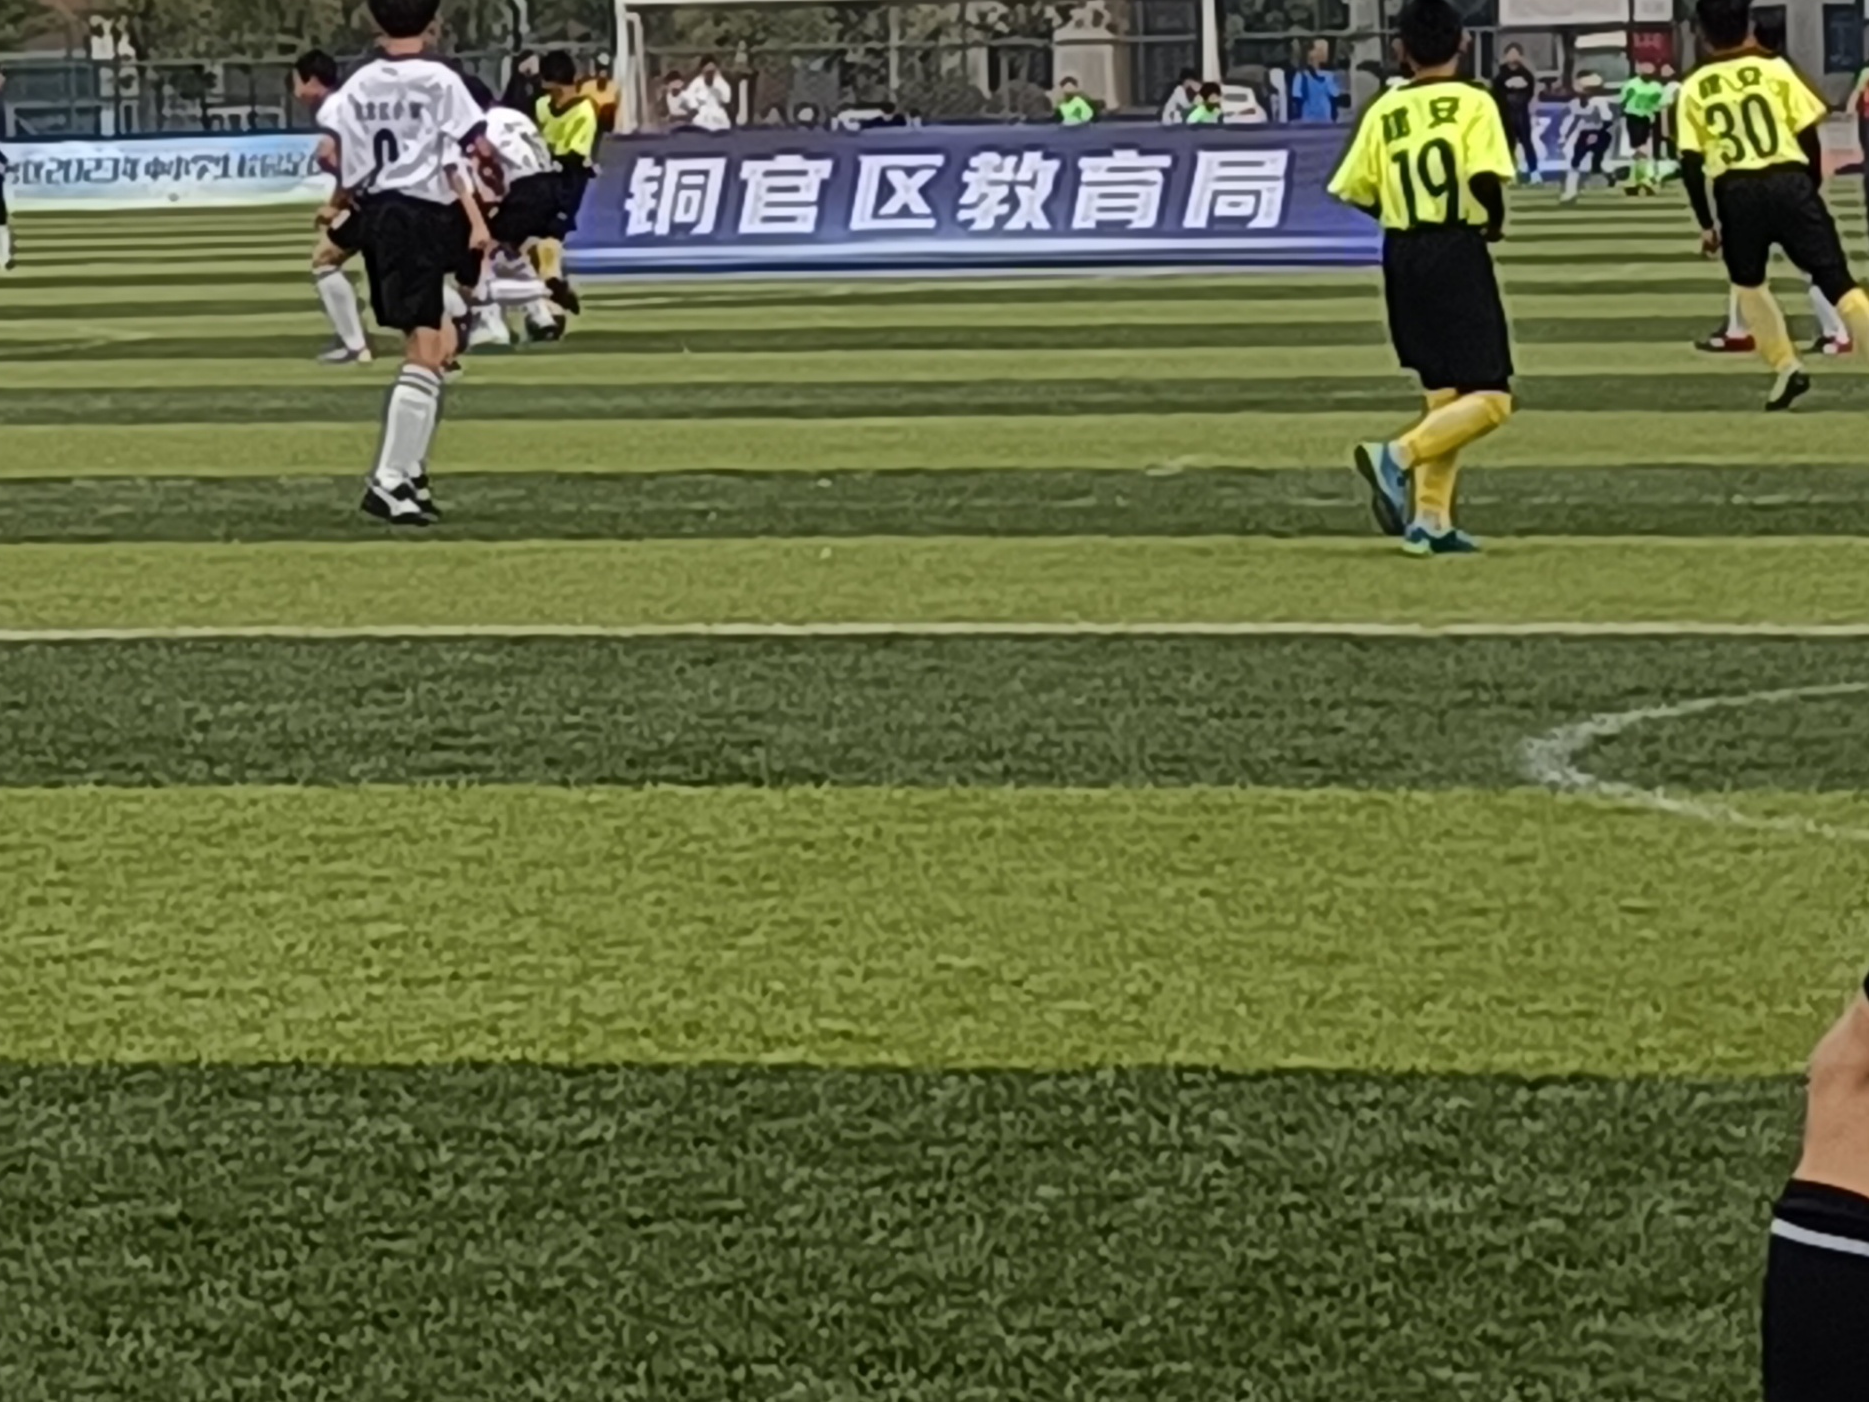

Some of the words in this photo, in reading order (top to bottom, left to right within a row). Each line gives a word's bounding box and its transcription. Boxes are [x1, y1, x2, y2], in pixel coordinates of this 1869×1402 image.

[1706, 92, 1779, 165] 30
[624, 149, 1291, 237] 铜官区教育局
[1391, 136, 1460, 226] 19
